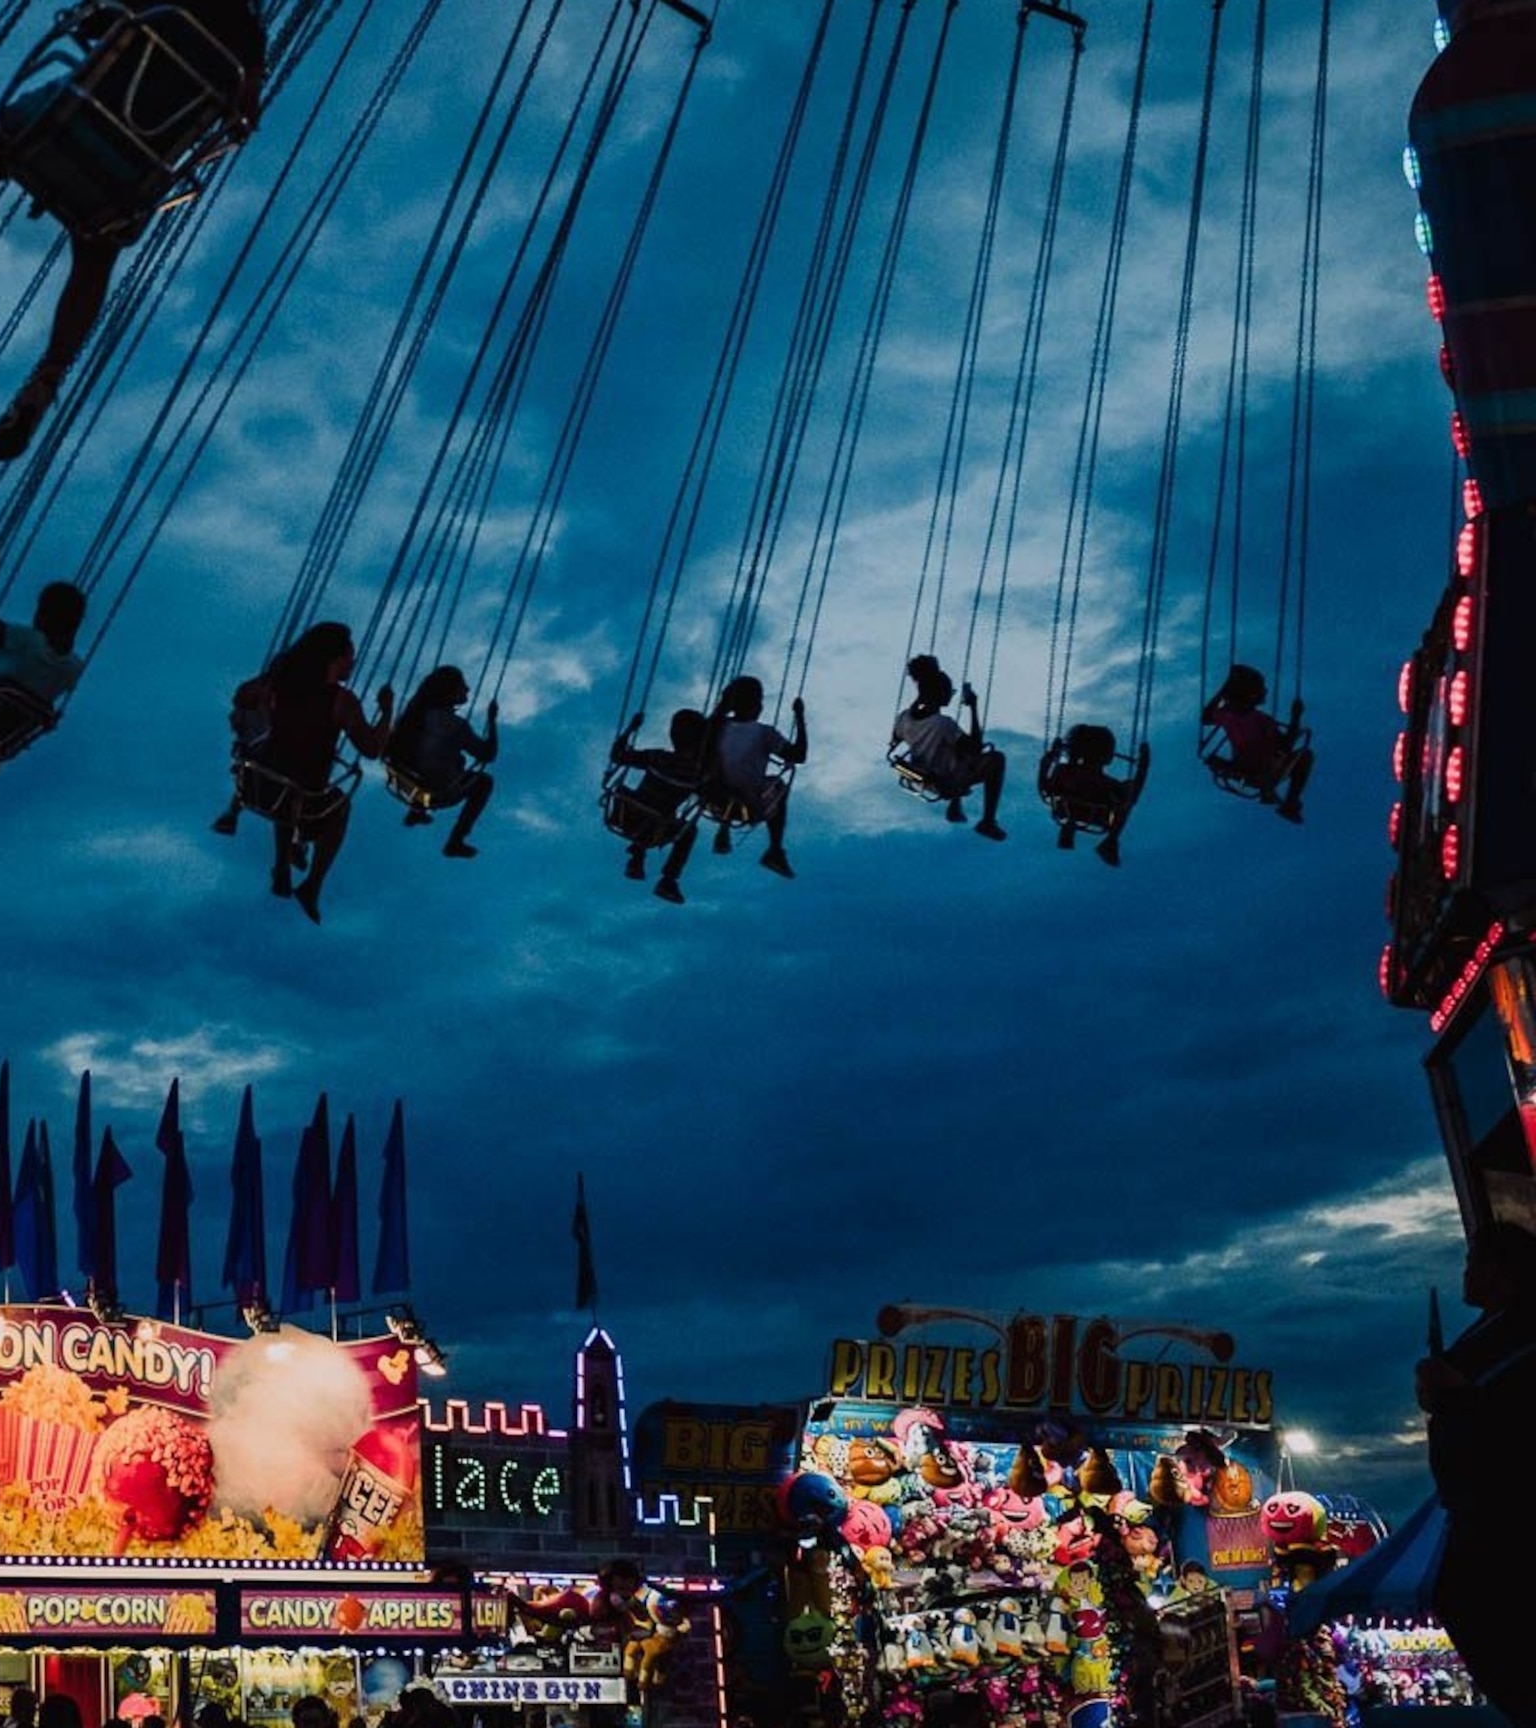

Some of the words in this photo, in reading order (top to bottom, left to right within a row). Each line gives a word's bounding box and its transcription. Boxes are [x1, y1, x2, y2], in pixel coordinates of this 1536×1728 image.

[62, 1326, 214, 1396] CANDY!
[831, 1339, 1000, 1405] PRIZES
[1007, 1314, 1122, 1412] BIG
[1125, 1361, 1272, 1424] PRIZES
[666, 1418, 769, 1473] BIG
[30, 1478, 61, 1494] POP
[435, 1445, 560, 1516] lace
[27, 1596, 78, 1625] POP
[95, 1596, 165, 1626] CORN
[248, 1600, 336, 1628] CANDY
[367, 1601, 455, 1629] APPLES
[545, 1681, 602, 1700] GUN
